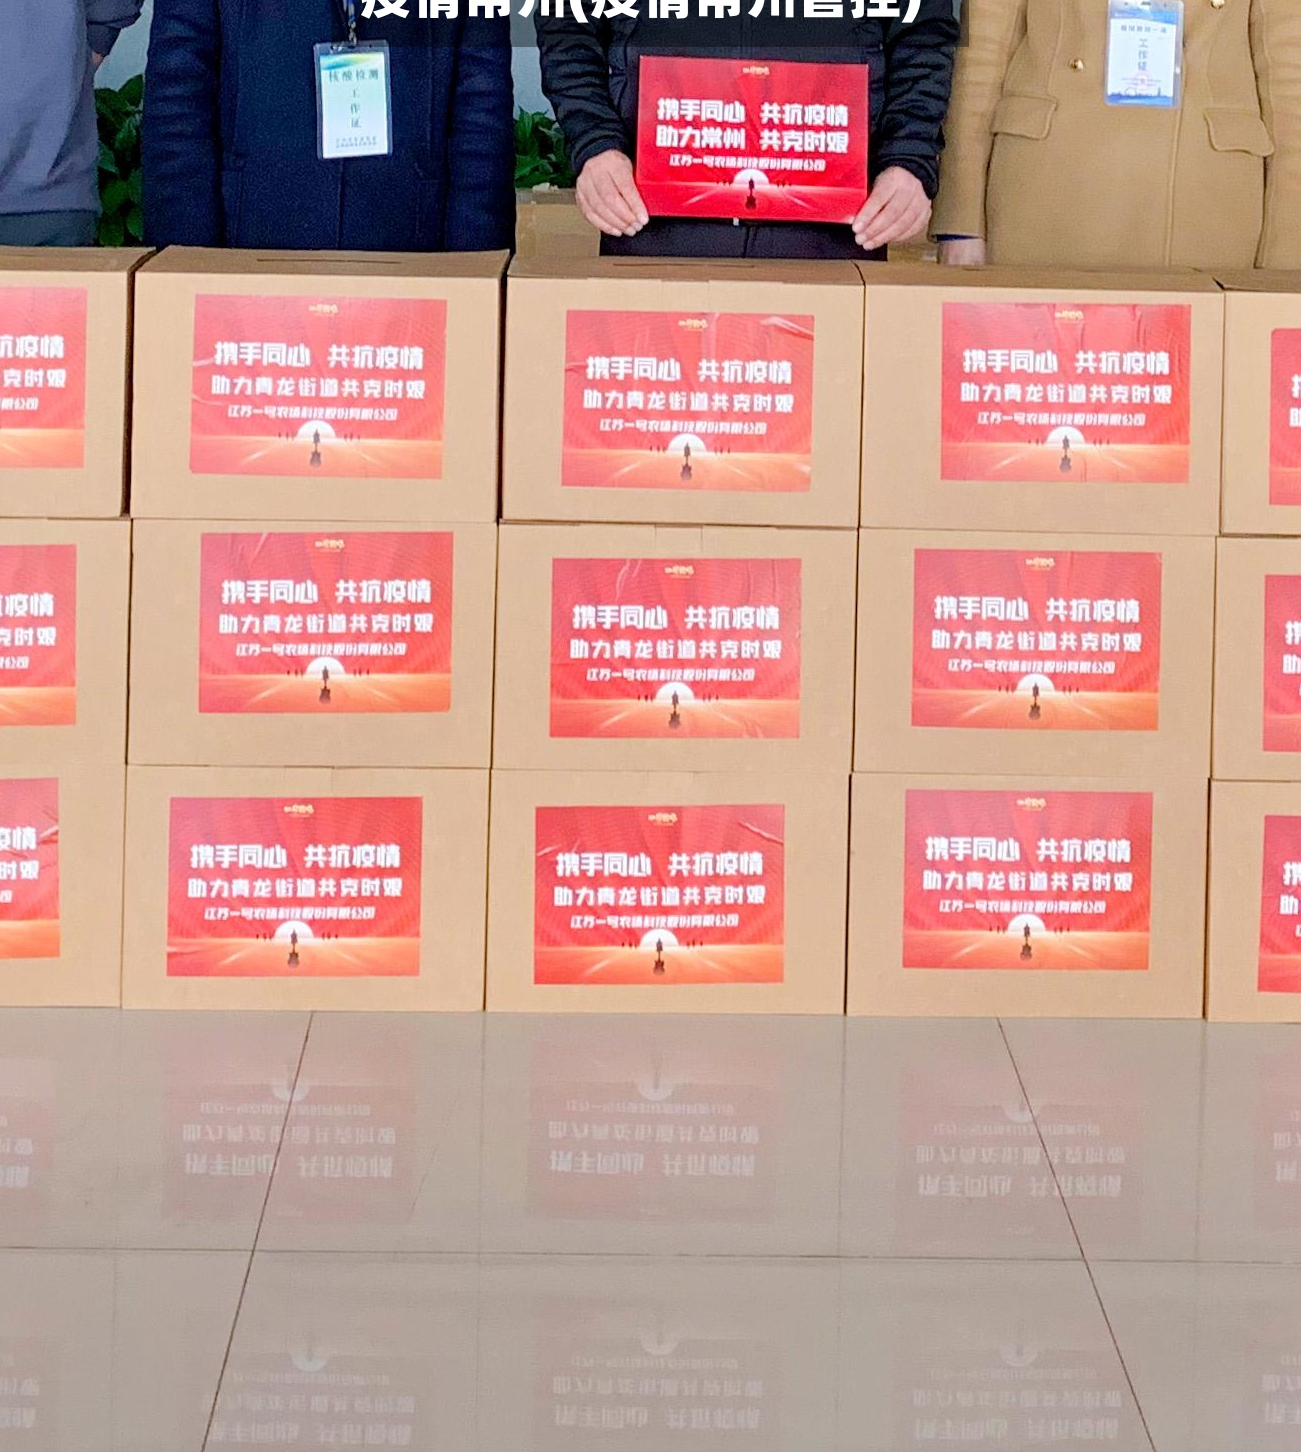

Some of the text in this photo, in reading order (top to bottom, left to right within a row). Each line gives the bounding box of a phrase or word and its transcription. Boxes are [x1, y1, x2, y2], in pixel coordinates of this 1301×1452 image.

[657, 98, 848, 126] 携手同心 共抗疫情
[655, 125, 849, 153] 助力常州 共克时艰
[213, 341, 423, 369] 携手同心 共抗疫情
[962, 349, 1170, 375] 携手同心 共抗疫情
[586, 356, 792, 384] 携手同心 共抗疫情
[222, 579, 431, 604] 携手同心 共抗疫情
[572, 605, 779, 629] 携手同心 共抗疫情
[934, 596, 1140, 622] 携手同心 共抗疫情
[190, 844, 400, 868] 携手同心 共抗疫情
[925, 837, 1131, 862] 携手同心 共抗疫情
[556, 851, 763, 877] 携手同心 共抗疫情
